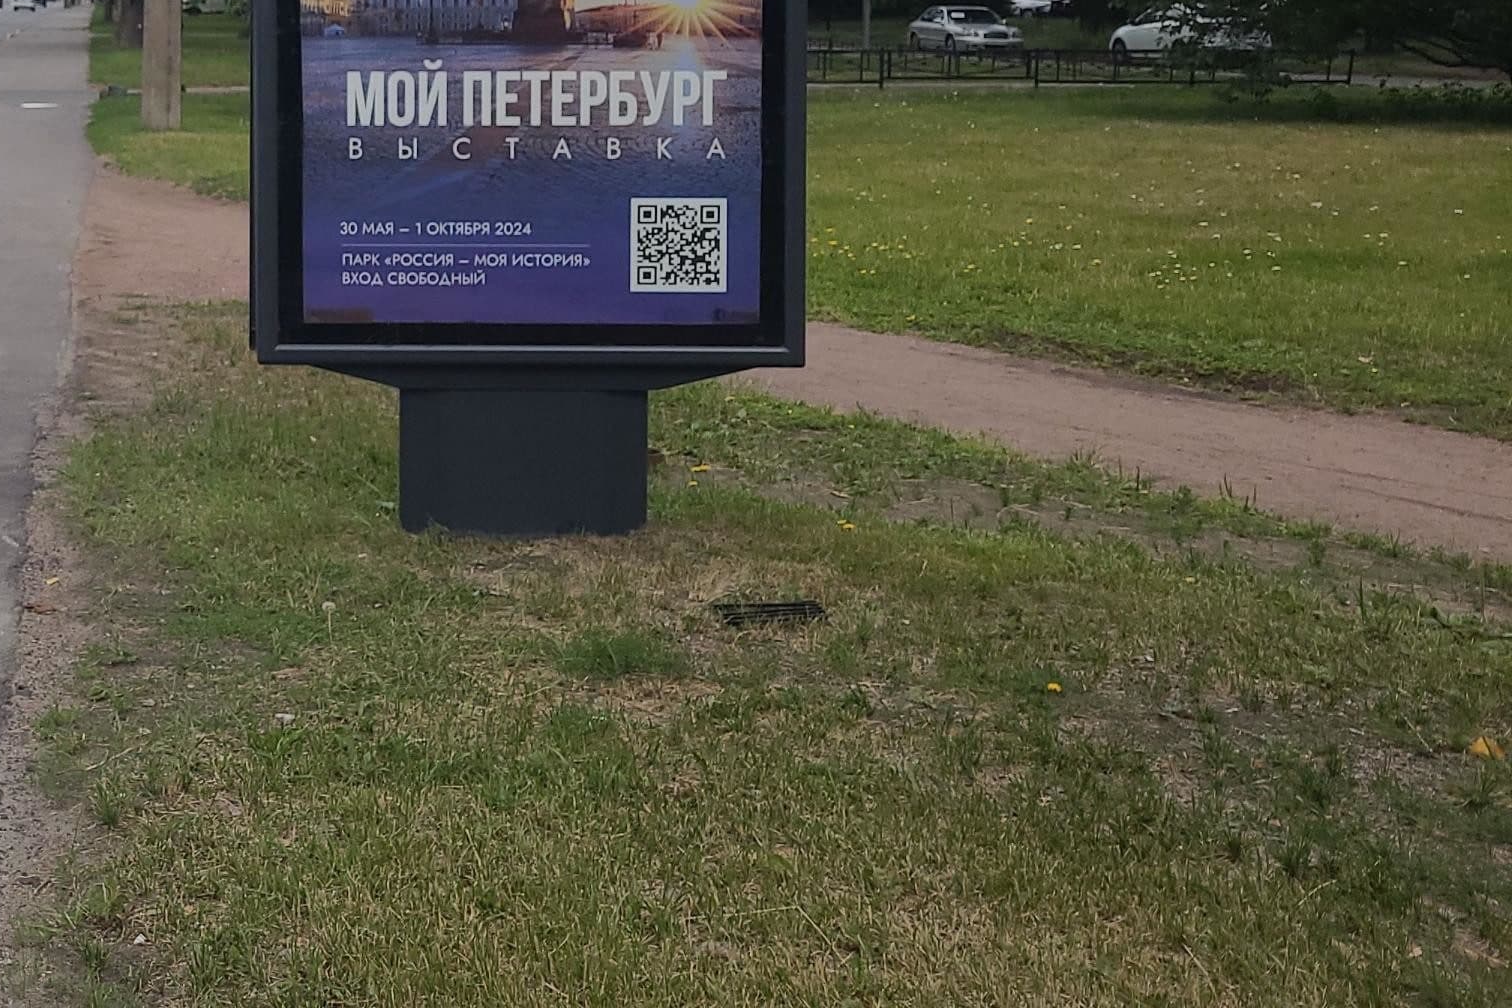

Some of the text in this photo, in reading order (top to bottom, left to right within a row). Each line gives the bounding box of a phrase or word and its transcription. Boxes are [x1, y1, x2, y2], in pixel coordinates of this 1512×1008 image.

[345, 58, 728, 128] МОЙ ПЕТЕРБУРГ
[348, 136, 726, 160] ВЫСТАВКА
[339, 222, 358, 235] 30
[362, 221, 394, 235] МАЯ
[415, 222, 422, 235] 1
[426, 221, 490, 235] ОКТЯБРЯ
[495, 221, 532, 235] 2024
[342, 253, 380, 266] ПАРК
[384, 253, 454, 266] «РОССИЯ
[474, 253, 508, 266] МОЯ
[512, 253, 591, 267] ИСТОРИЯ»
[342, 270, 486, 286] ВХОД СВОБОДНЫЙ
